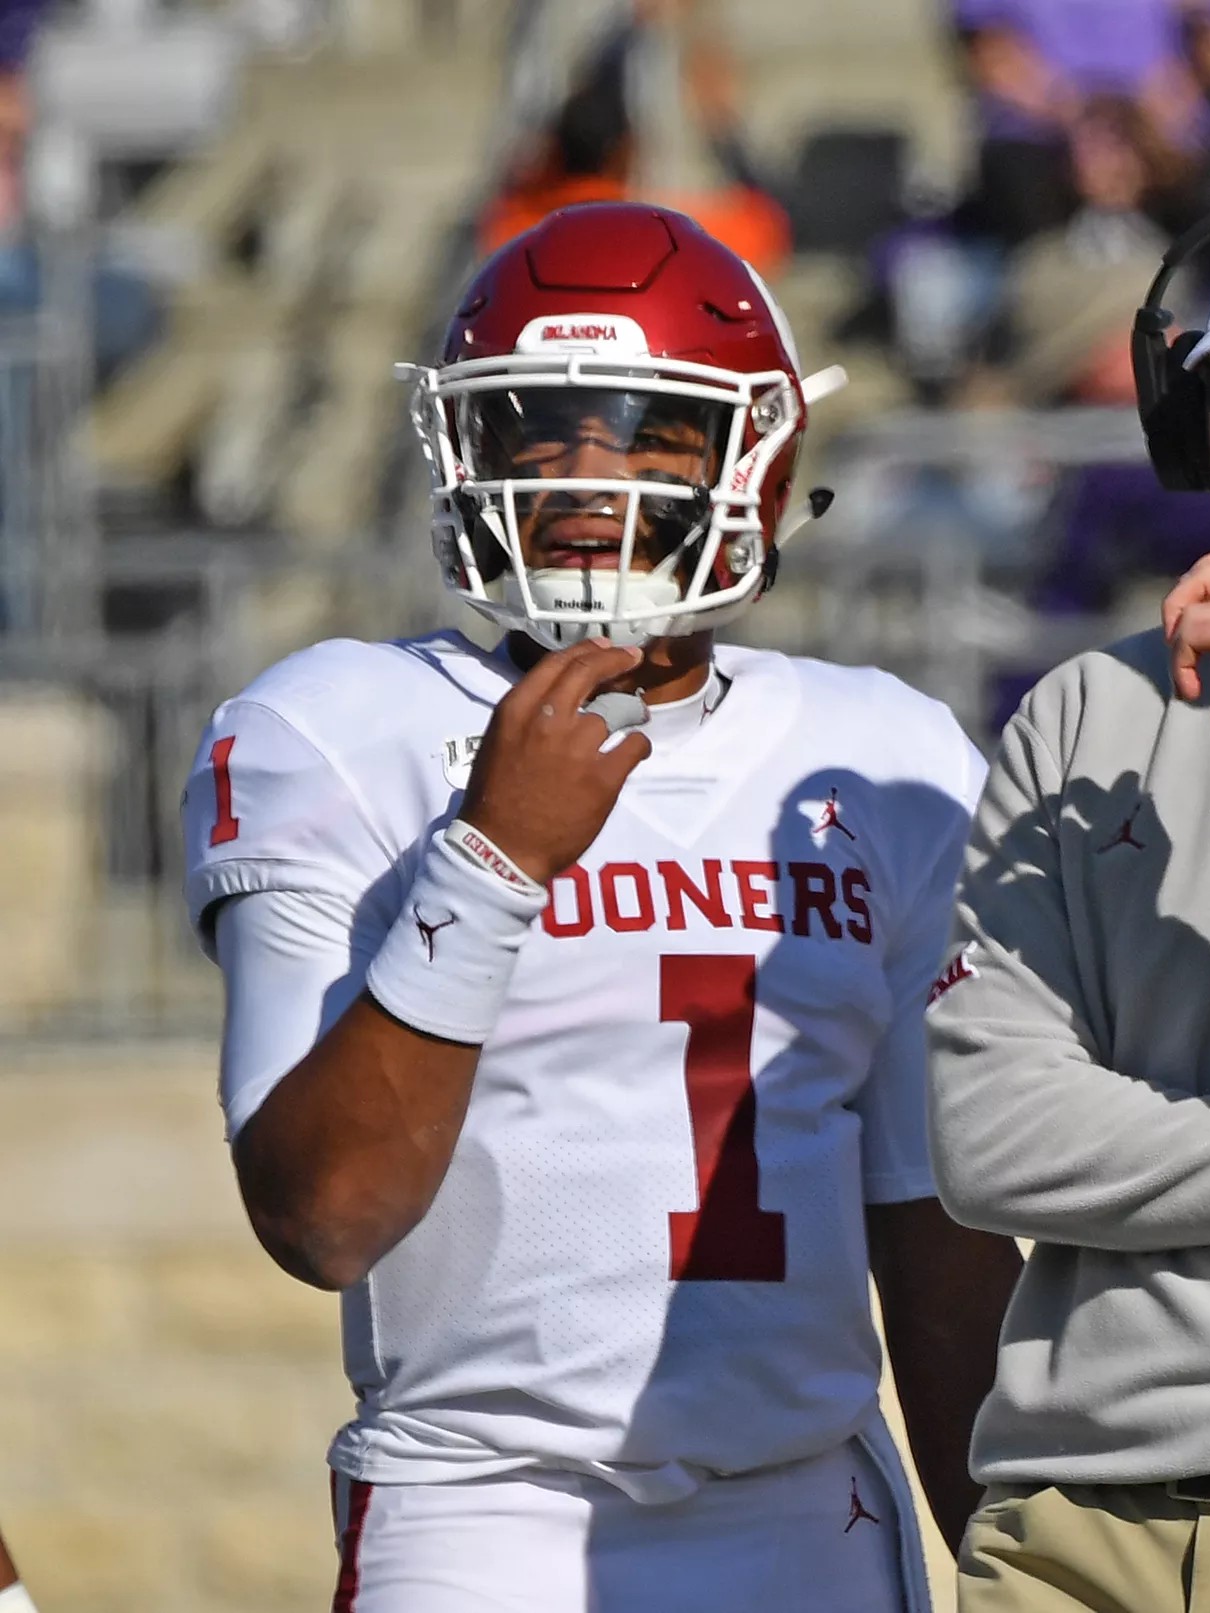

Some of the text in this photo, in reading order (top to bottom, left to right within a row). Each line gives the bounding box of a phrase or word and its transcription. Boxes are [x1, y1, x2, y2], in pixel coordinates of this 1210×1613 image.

[207, 734, 240, 849] 1
[541, 857, 873, 945] OONERS
[659, 953, 787, 1283] 1
